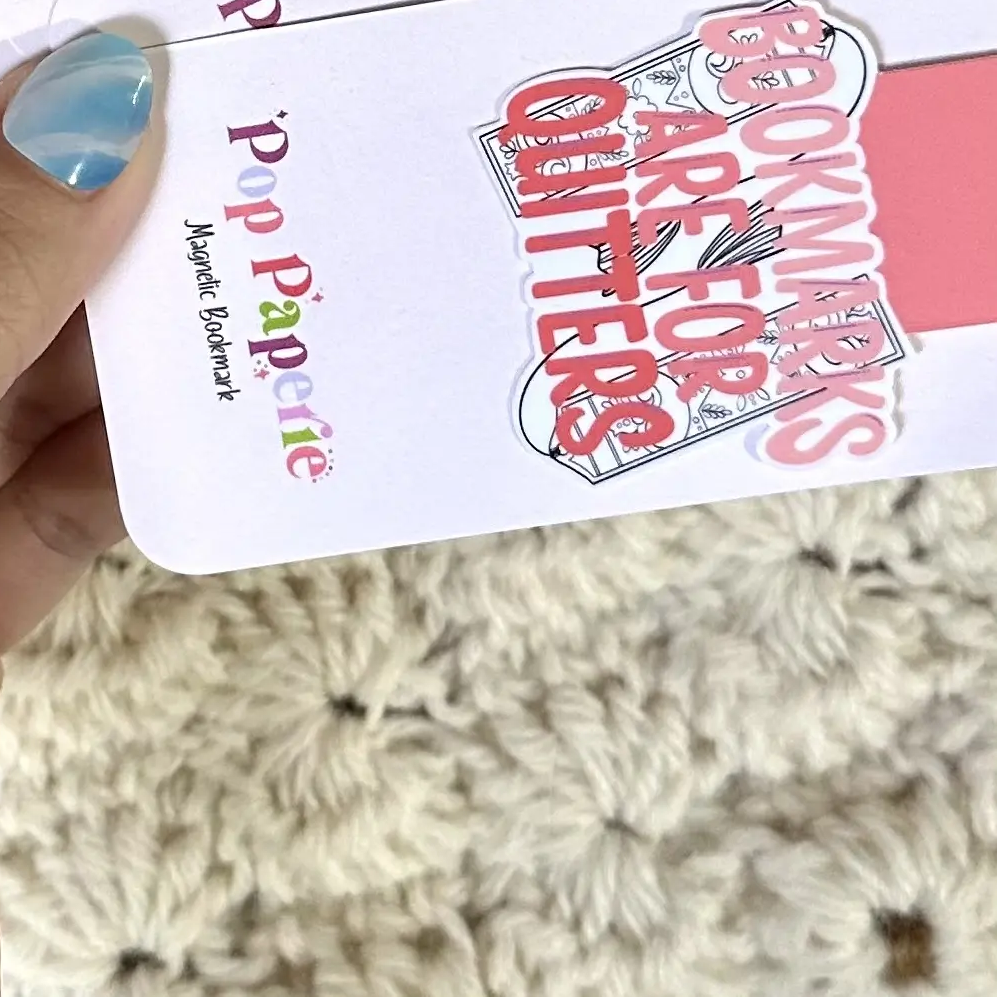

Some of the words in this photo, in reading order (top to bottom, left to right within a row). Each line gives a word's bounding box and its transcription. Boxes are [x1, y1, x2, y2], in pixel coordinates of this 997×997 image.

[224, 120, 289, 235] Pop
[633, 111, 750, 249] ARE
[699, 5, 887, 465] BOOKMARKS
[183, 218, 218, 301] Magnetic
[497, 76, 675, 457] QUITTERS
[199, 305, 240, 402] Bookmark
[247, 253, 333, 479] Paperie
[646, 264, 769, 403] FOR
